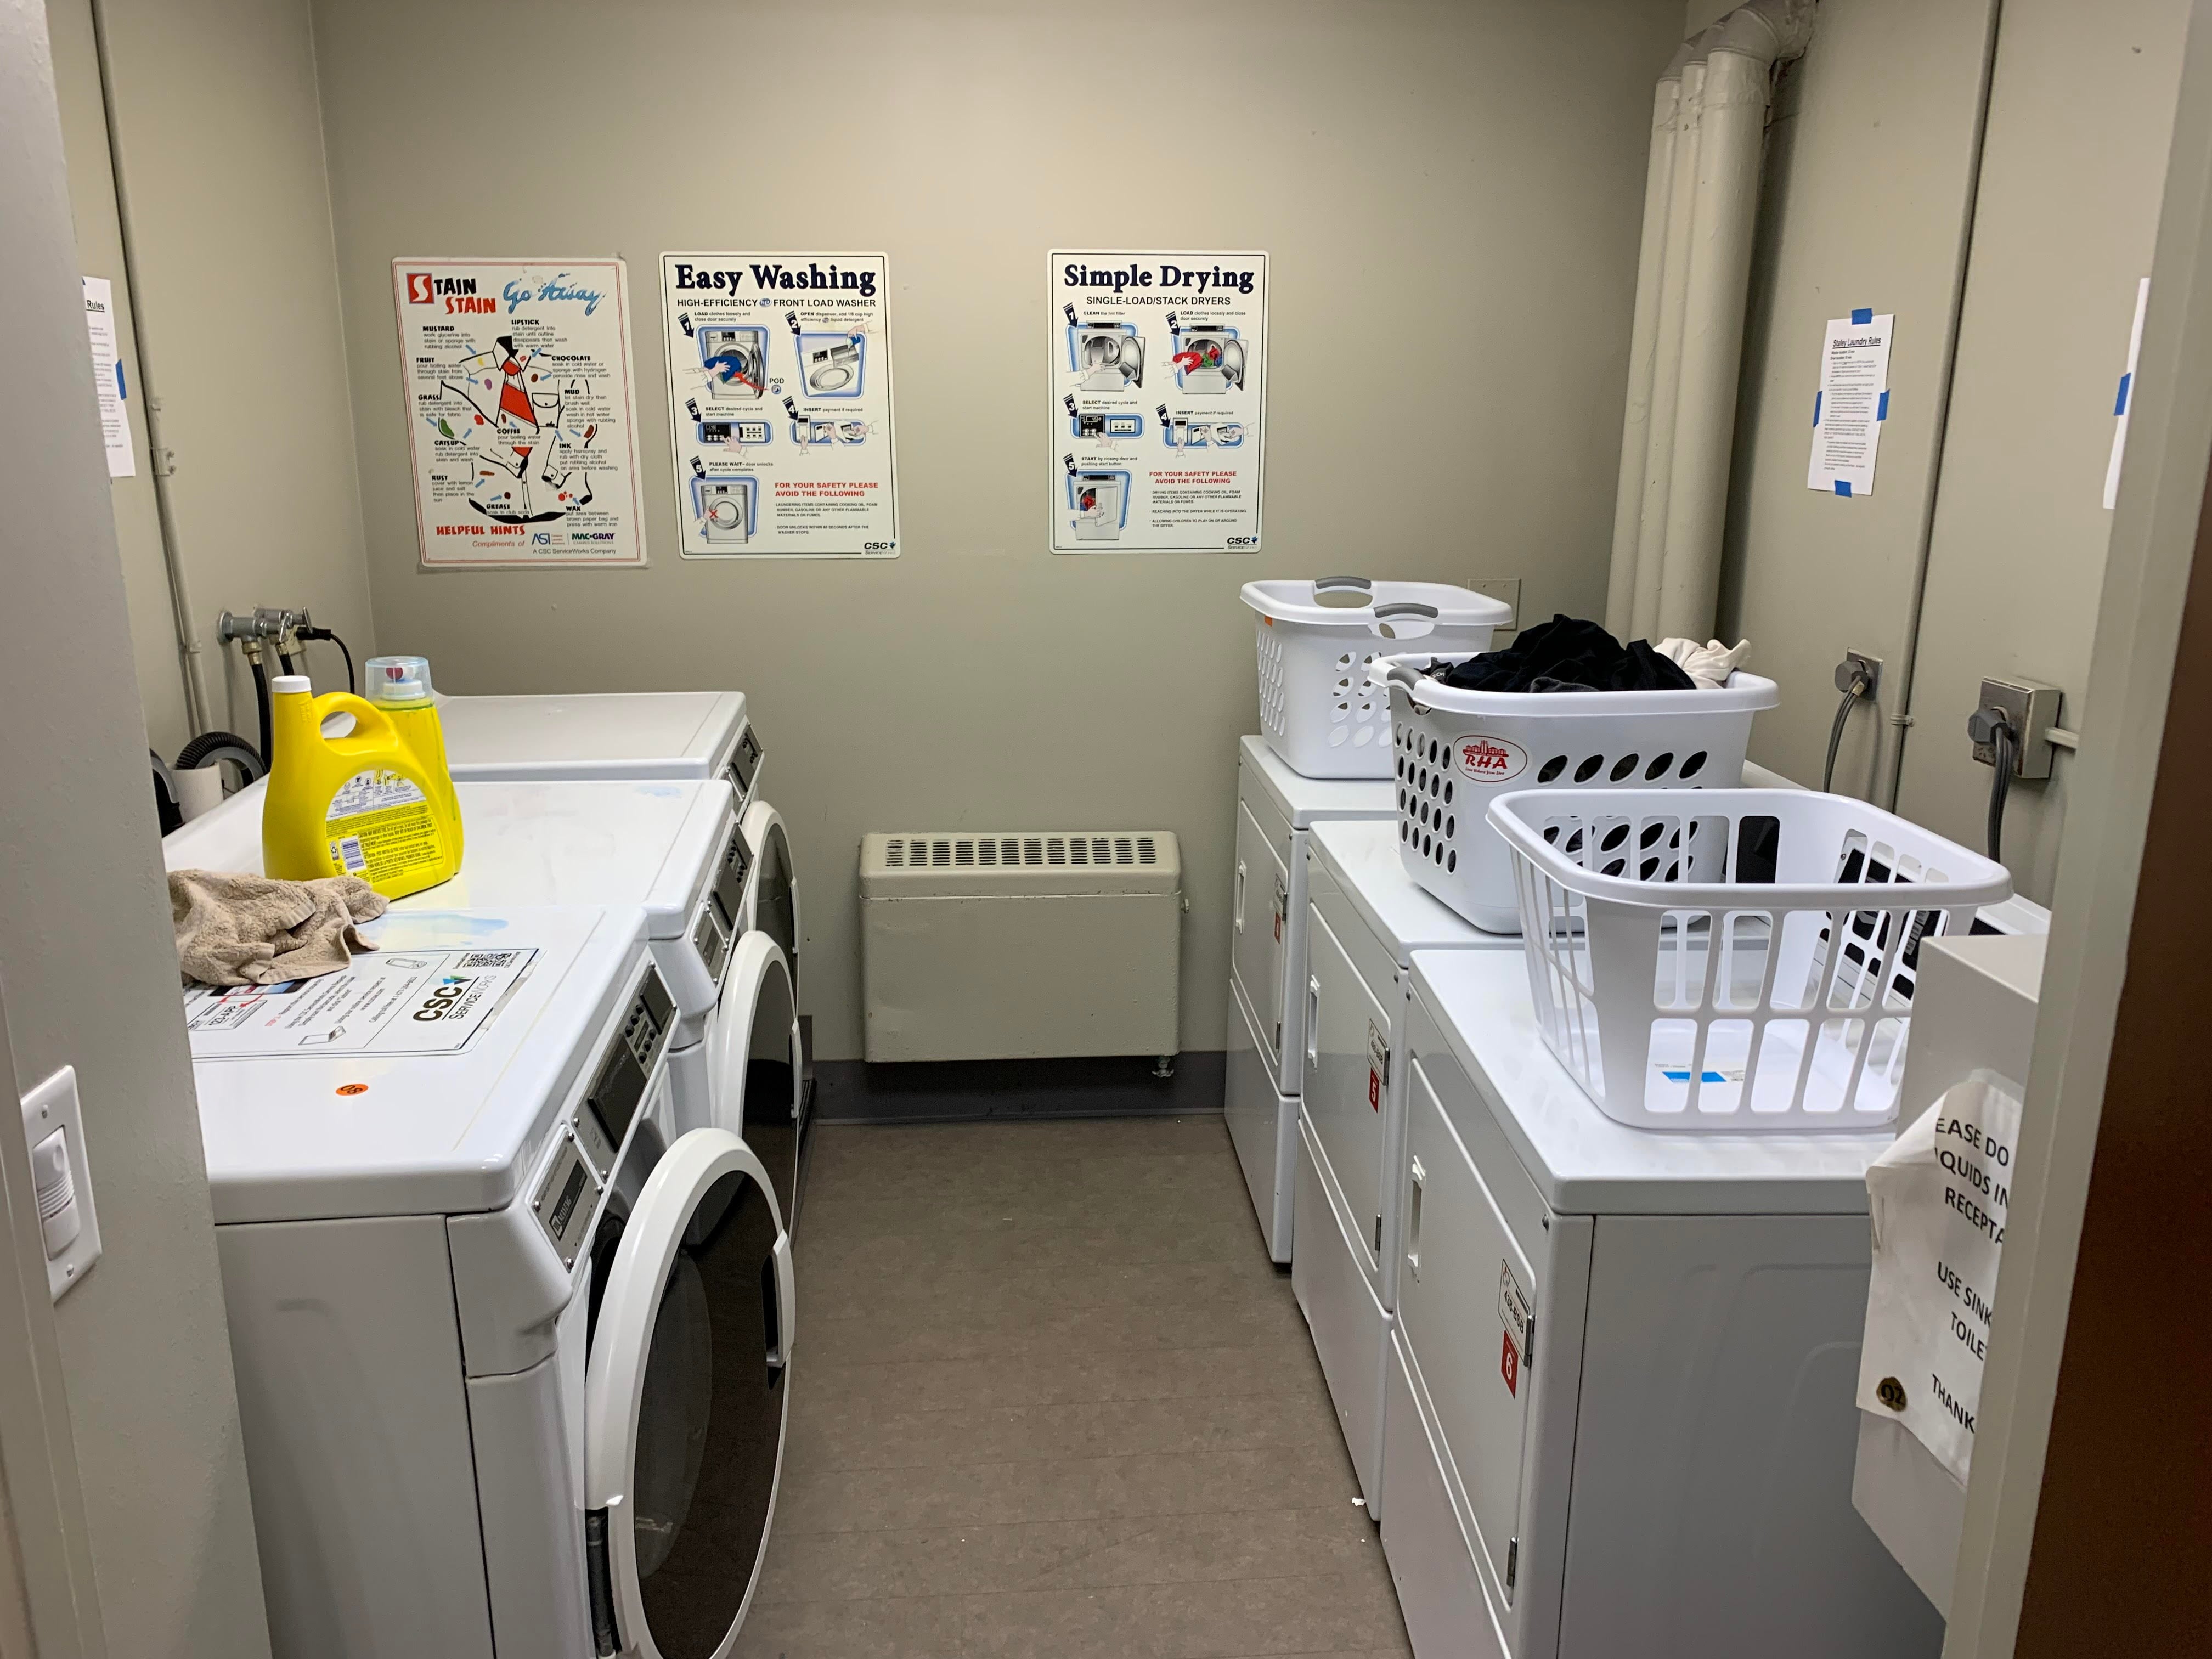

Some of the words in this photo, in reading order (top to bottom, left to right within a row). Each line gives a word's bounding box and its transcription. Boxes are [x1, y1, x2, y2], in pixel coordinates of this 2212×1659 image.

[675, 263, 744, 297] Easy
[749, 263, 876, 297] Washing
[1064, 263, 1153, 294] Simple
[1159, 263, 1255, 294] Drying
[411, 275, 477, 302] STAIN
[503, 279, 532, 314] Go
[538, 273, 608, 316] Away
[86, 299, 105, 311] Rules
[445, 296, 496, 314] STAIN
[678, 298, 758, 307] HIGH-EFFICIENCY
[774, 298, 805, 307] FRONT
[808, 298, 833, 307] LOAD
[836, 298, 876, 307] WASHER
[1086, 296, 1188, 306] SINGLE-LOAD/STACK
[1191, 296, 1231, 306] DRYERS
[1069, 312, 1074, 320] 1
[791, 320, 798, 329] 2
[1171, 320, 1177, 329] 2
[1847, 337, 1867, 346] Laundry
[1869, 336, 1882, 345] Rules
[691, 407, 698, 415] 3
[695, 465, 703, 473] 5
[1068, 462, 1074, 470] 5
[436, 525, 485, 535] HELPFUL
[490, 525, 526, 535] HINTS
[1465, 754, 1508, 769] RHA
[413, 986, 463, 1022] CSC
[1985, 1137, 2010, 1167] DO
[1937, 1260, 1962, 1297] USE
[1951, 1311, 1988, 1361] TOILE
